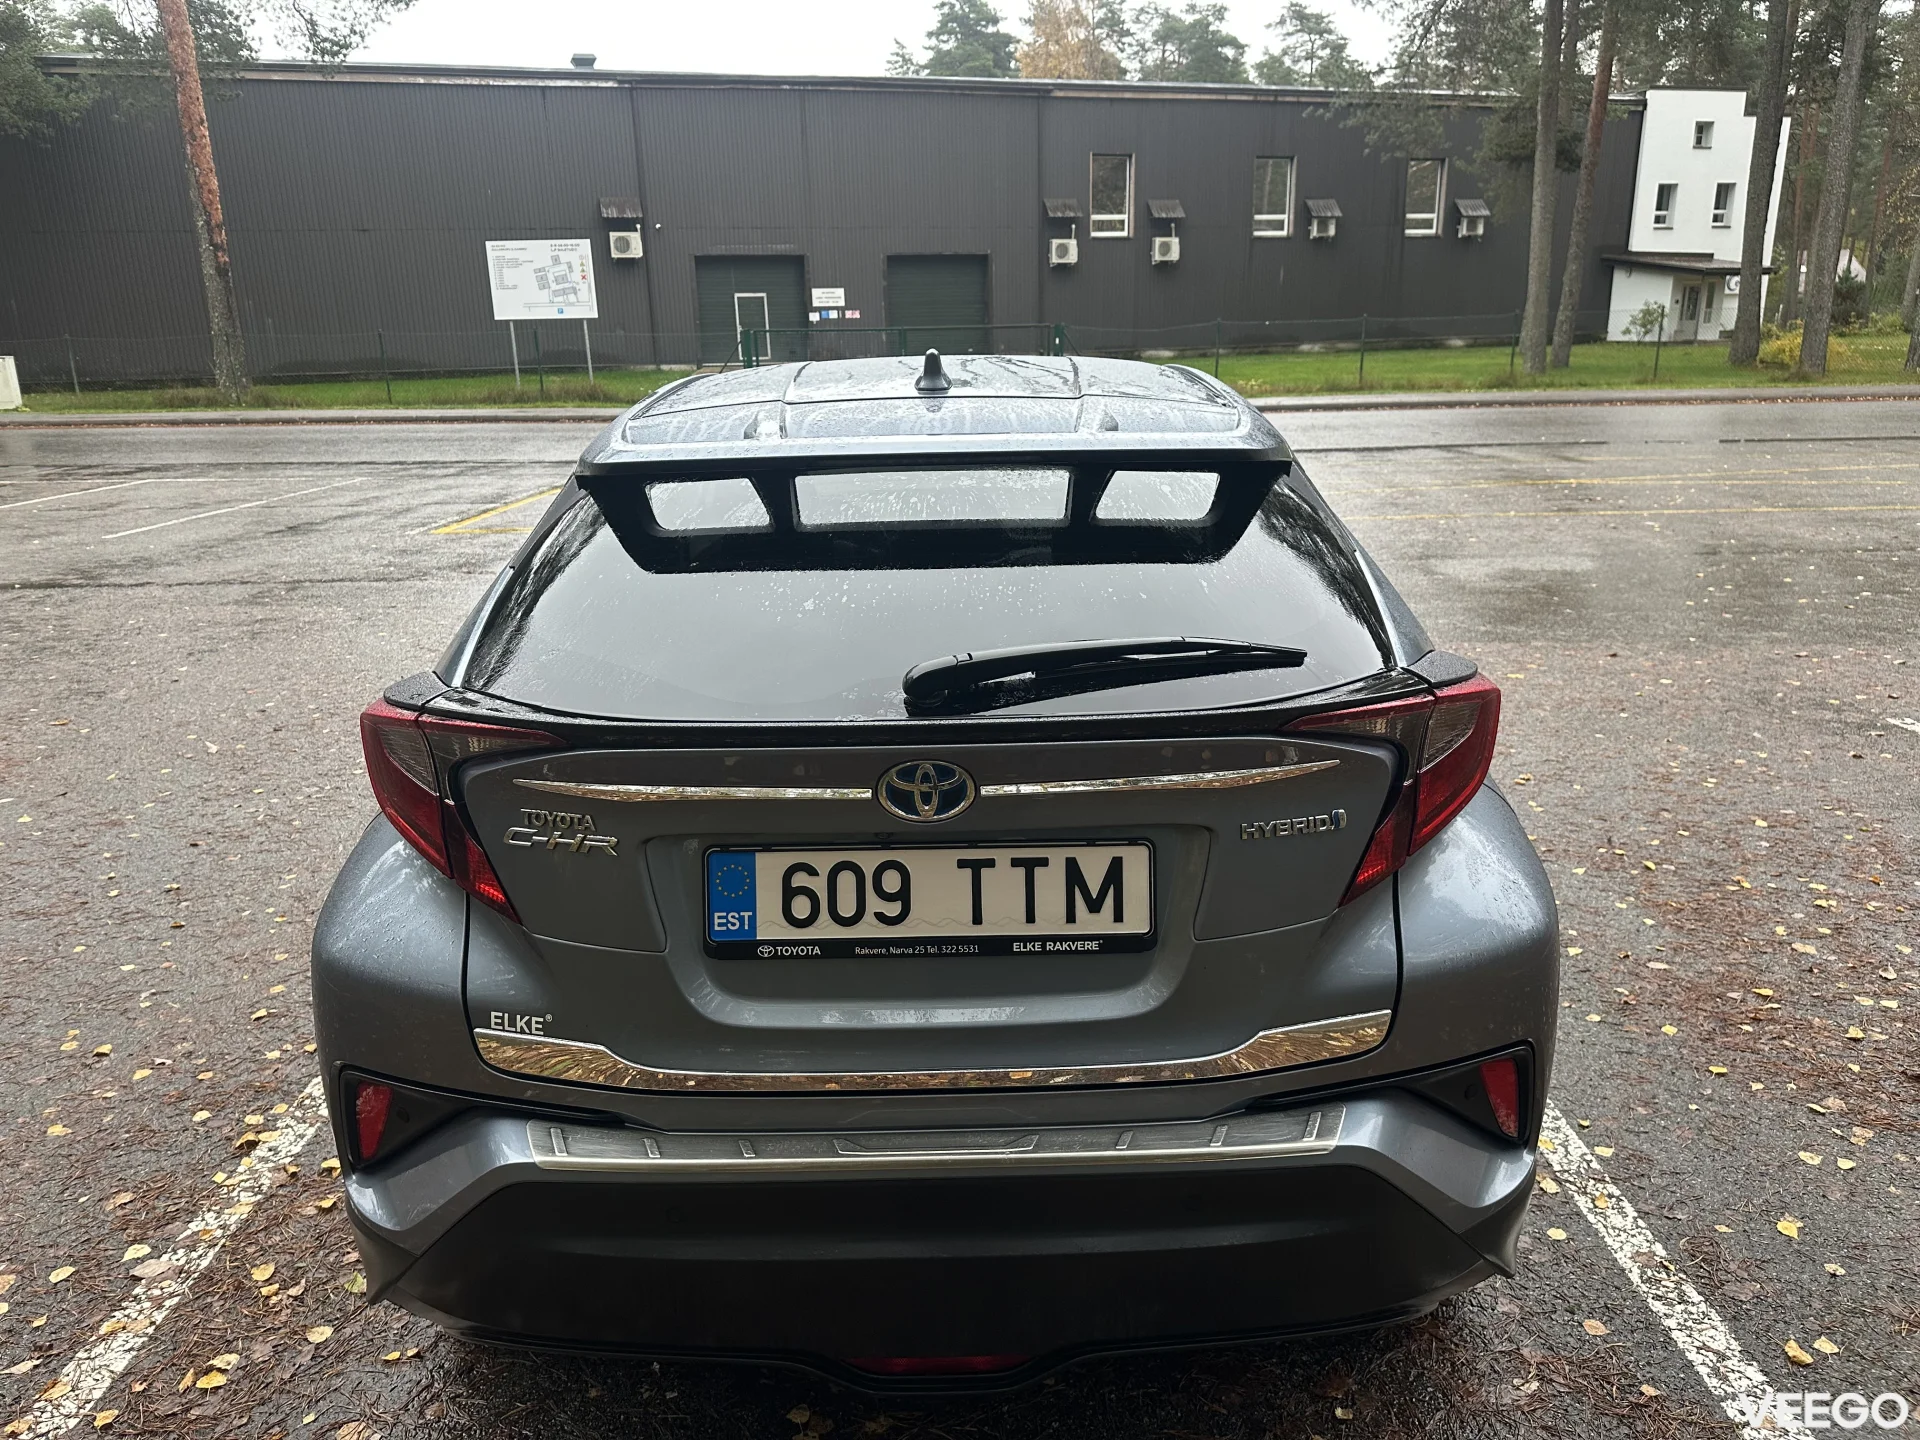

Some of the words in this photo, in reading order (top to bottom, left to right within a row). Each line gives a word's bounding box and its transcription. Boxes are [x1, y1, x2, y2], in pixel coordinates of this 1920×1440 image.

[520, 808, 596, 832] TOYOTA
[1241, 814, 1331, 840] HYBRID
[503, 826, 619, 856] C-HR
[781, 858, 912, 928] 609
[956, 856, 1124, 925] TTM
[714, 911, 753, 931] EST
[775, 946, 821, 956] TOYOTA
[855, 946, 889, 955] Rakvere,
[889, 946, 913, 954] Narva
[914, 945, 925, 954] 25
[926, 945, 940, 953] Tel.
[941, 945, 957, 953] 322
[958, 944, 979, 953] 5531
[1013, 942, 1042, 952] ELKE
